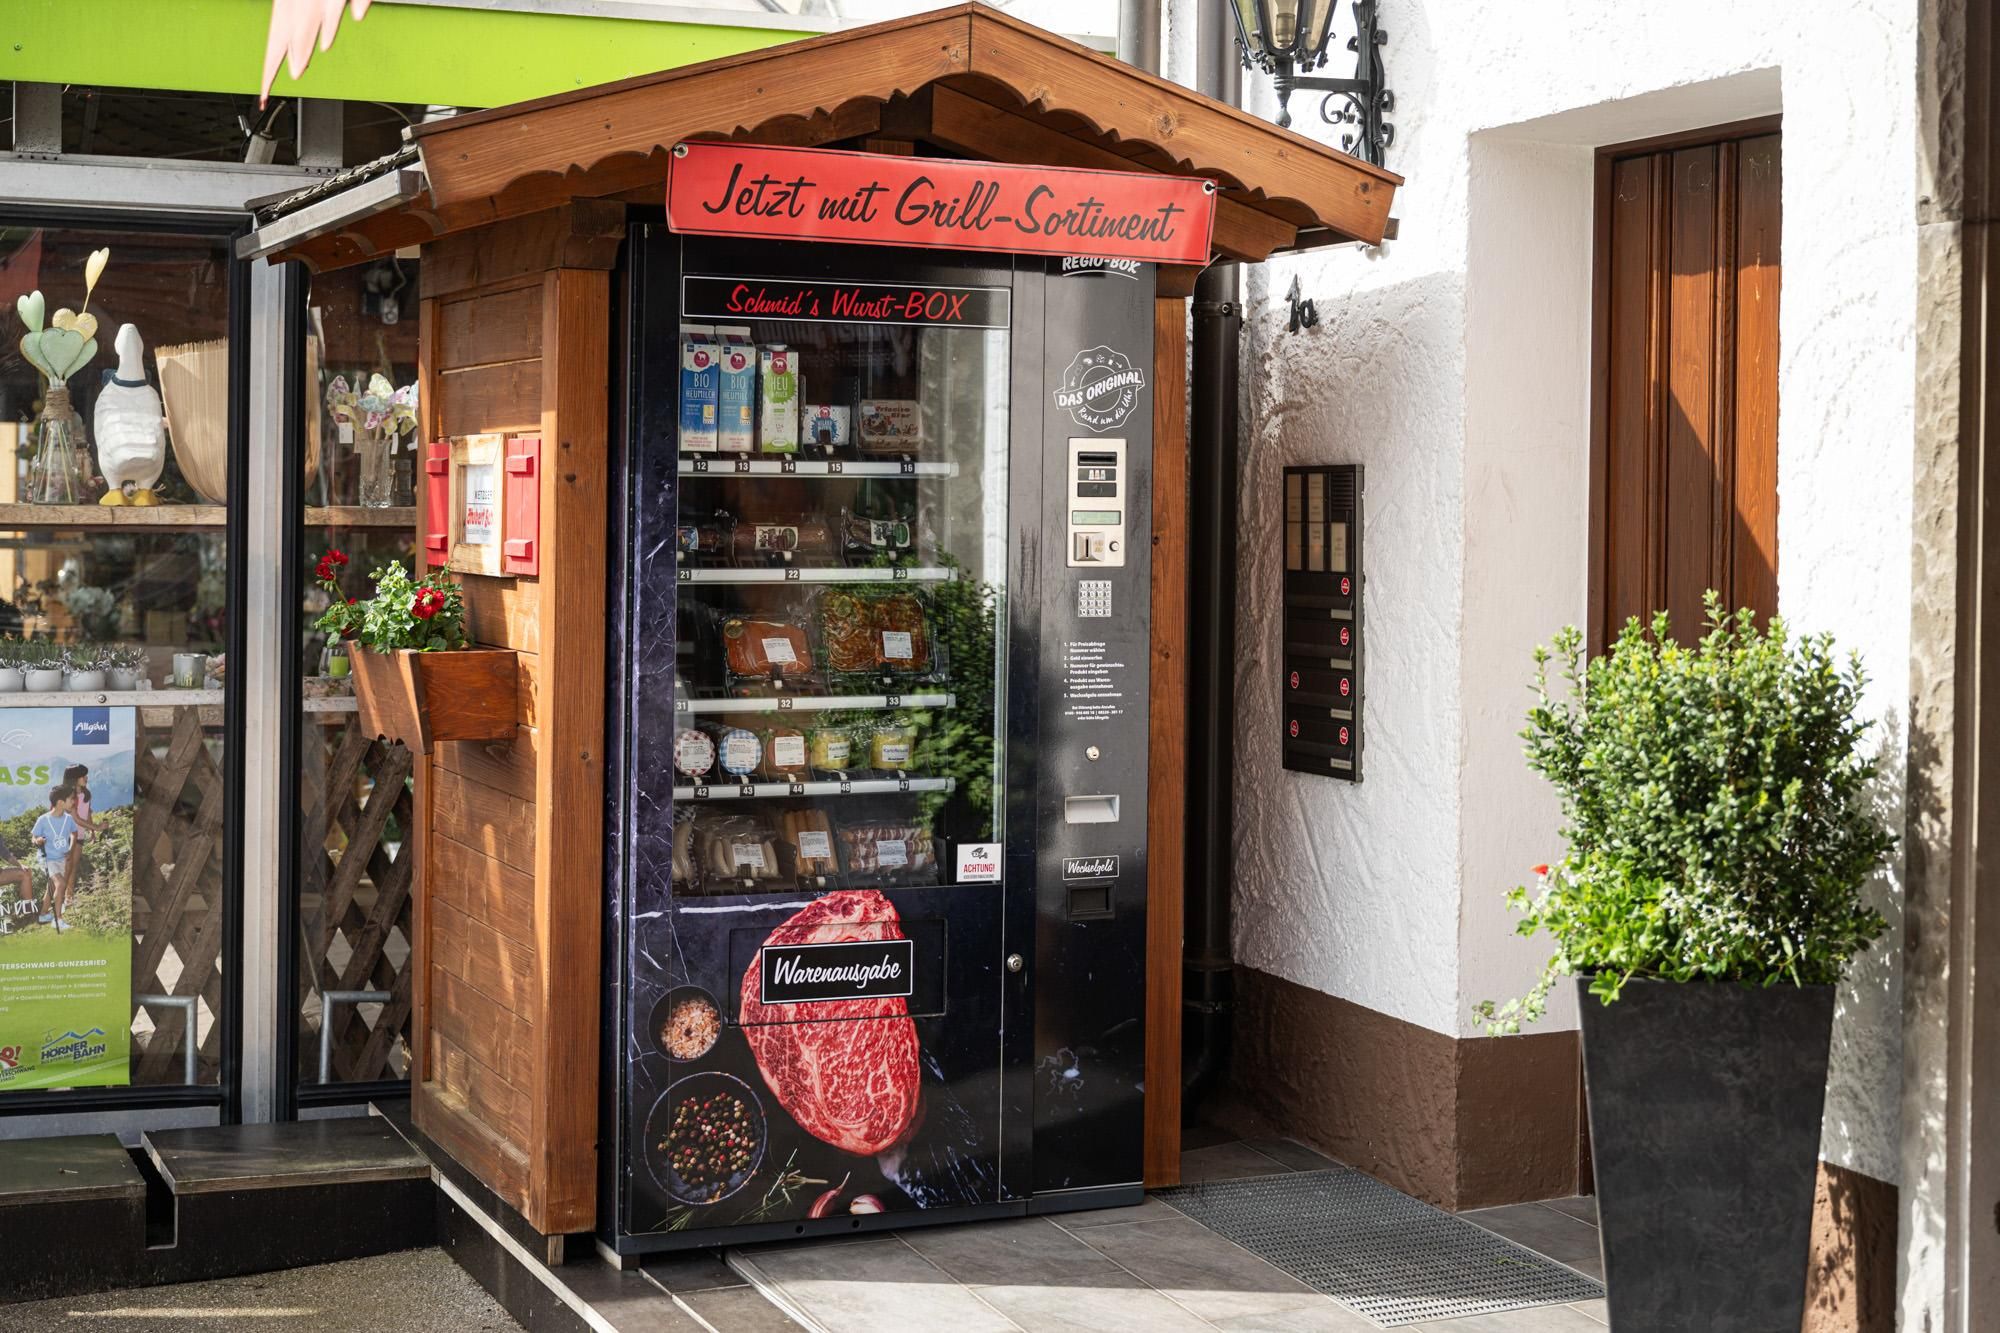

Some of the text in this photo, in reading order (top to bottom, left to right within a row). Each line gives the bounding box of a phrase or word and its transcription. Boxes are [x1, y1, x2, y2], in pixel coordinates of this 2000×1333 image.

[702, 162, 1186, 242] Jetzt mit Grill-Sortiment
[1062, 256, 1141, 274] REGIO-BOX
[831, 288, 971, 321] Wurst-BOX
[694, 373, 710, 388] BIO
[731, 375, 747, 390] BIO
[772, 376, 788, 391] HEU
[1058, 371, 1142, 407] DAS ORIGINAL
[1078, 388, 1133, 425] Rund um die Uhr
[697, 462, 706, 471] 12
[739, 462, 748, 471] 13
[784, 462, 794, 472] 14
[831, 463, 841, 472] 15
[904, 463, 913, 472] 16
[679, 570, 690, 579] 21
[788, 570, 800, 579] 22
[896, 568, 907, 578] 23
[780, 699, 791, 708] 32
[889, 696, 900, 705] 33
[676, 701, 686, 711] 31
[74, 722, 107, 736] Allgäu
[792, 784, 803, 794] 44
[900, 780, 909, 789] 47
[697, 787, 707, 797] 42
[743, 786, 753, 795] 43
[963, 863, 996, 873] ACHTUNG!
[1067, 858, 1114, 875] Wechselgeld
[773, 954, 902, 989] Warenausgabe
[73, 1043, 106, 1060] BAHN
